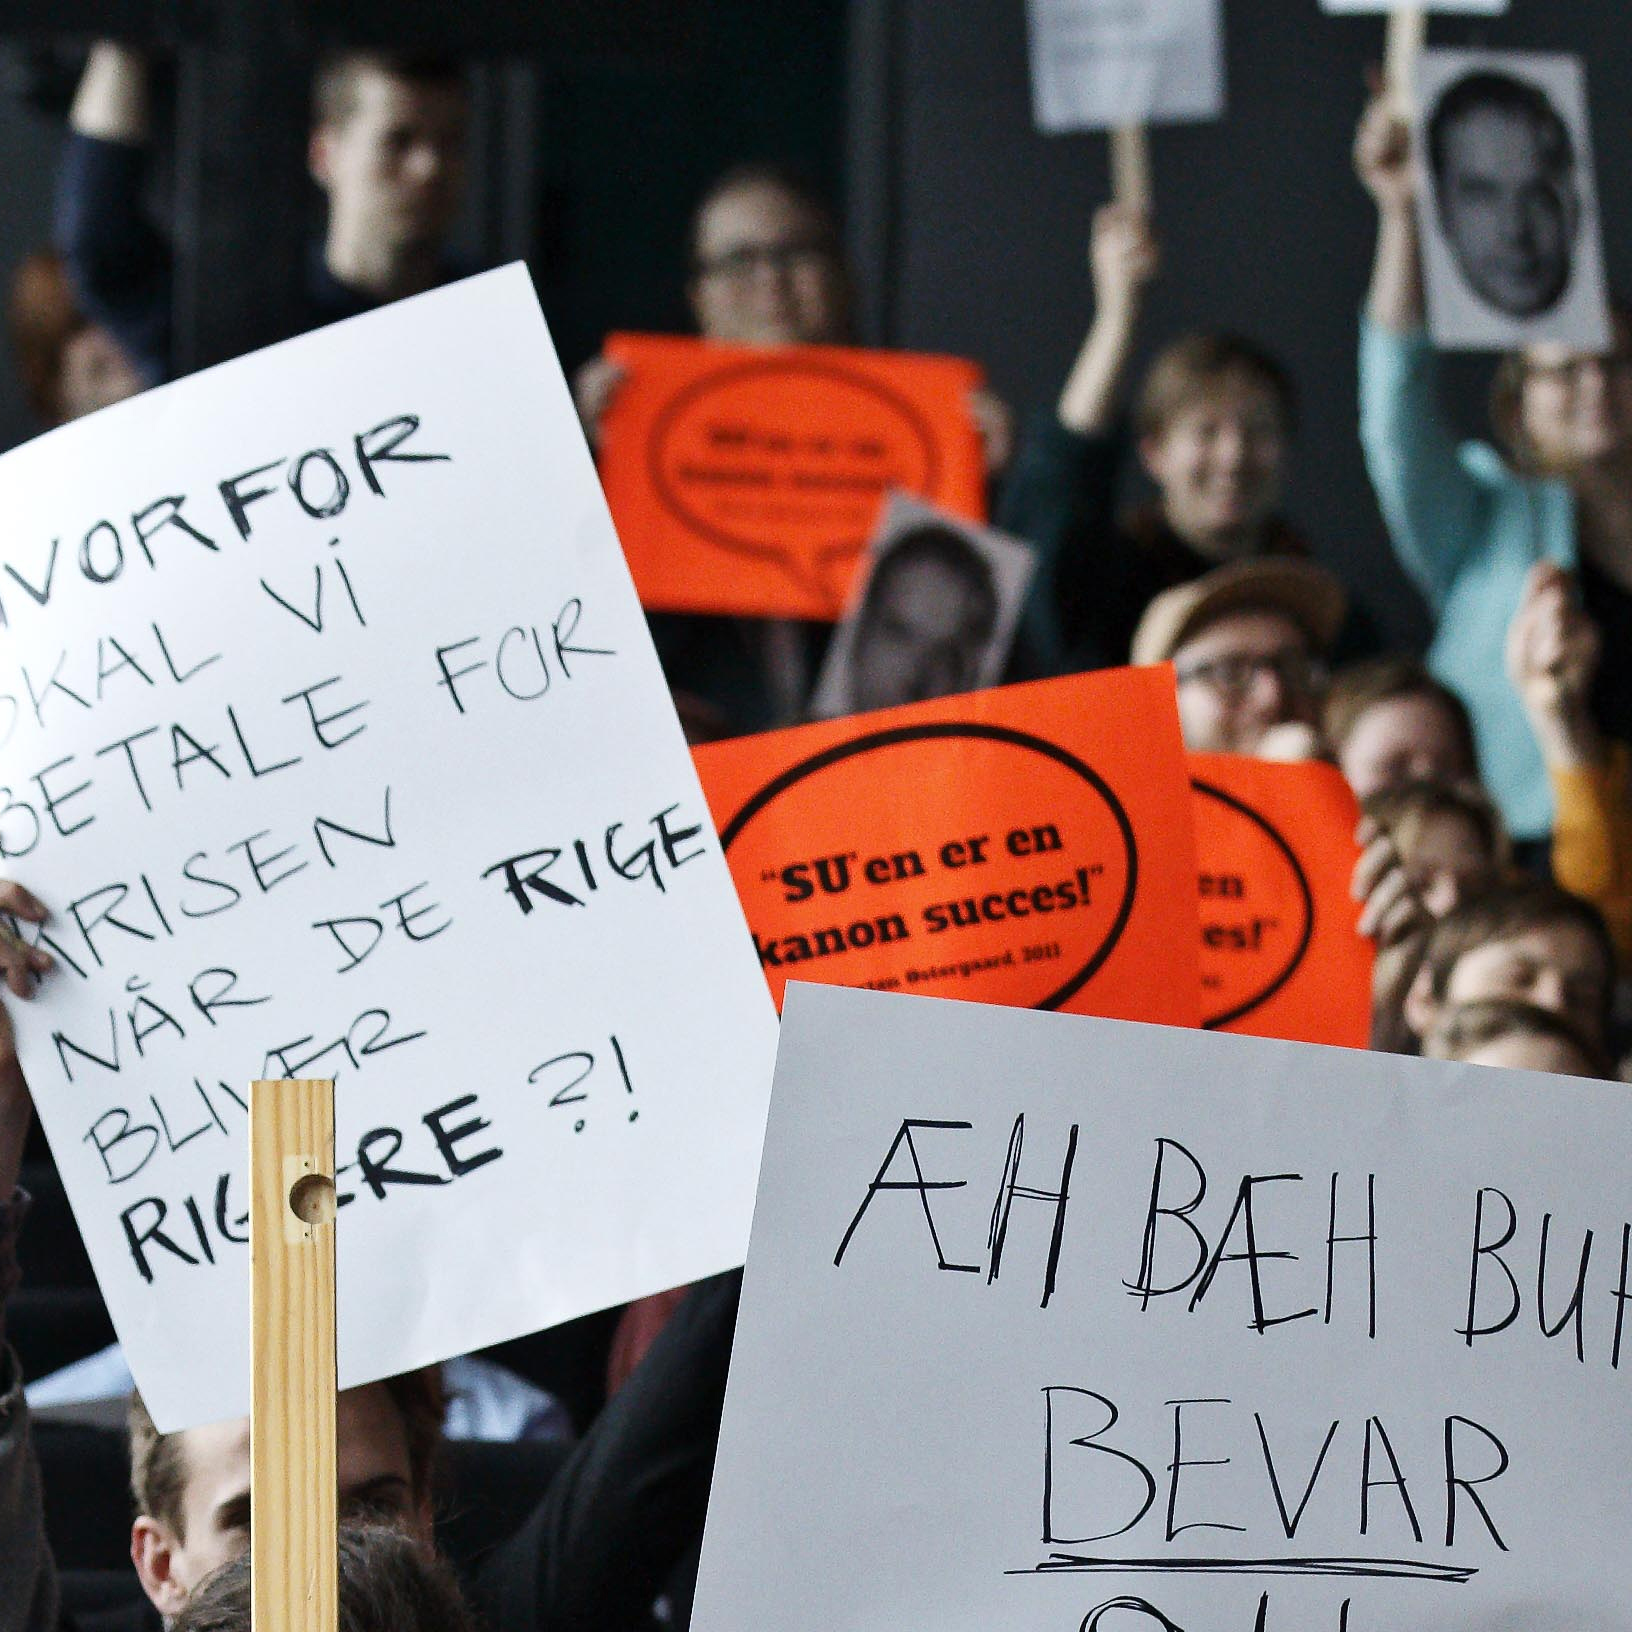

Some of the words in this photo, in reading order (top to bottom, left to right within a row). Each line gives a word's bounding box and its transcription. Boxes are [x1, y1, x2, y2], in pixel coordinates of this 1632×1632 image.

[436, 598, 617, 714] FOR
[939, 835, 989, 869] er
[1006, 823, 1063, 857] en
[50, 974, 271, 1085] NÅR
[312, 881, 454, 974] DE
[482, 803, 708, 916] RIGE
[752, 913, 910, 967] kanon
[120, 1094, 504, 1285] RIGRE
[834, 1112, 1079, 1308] ÆH
[1122, 1137, 1379, 1338] BÆH
[1041, 1386, 1510, 1552] BEVAR
